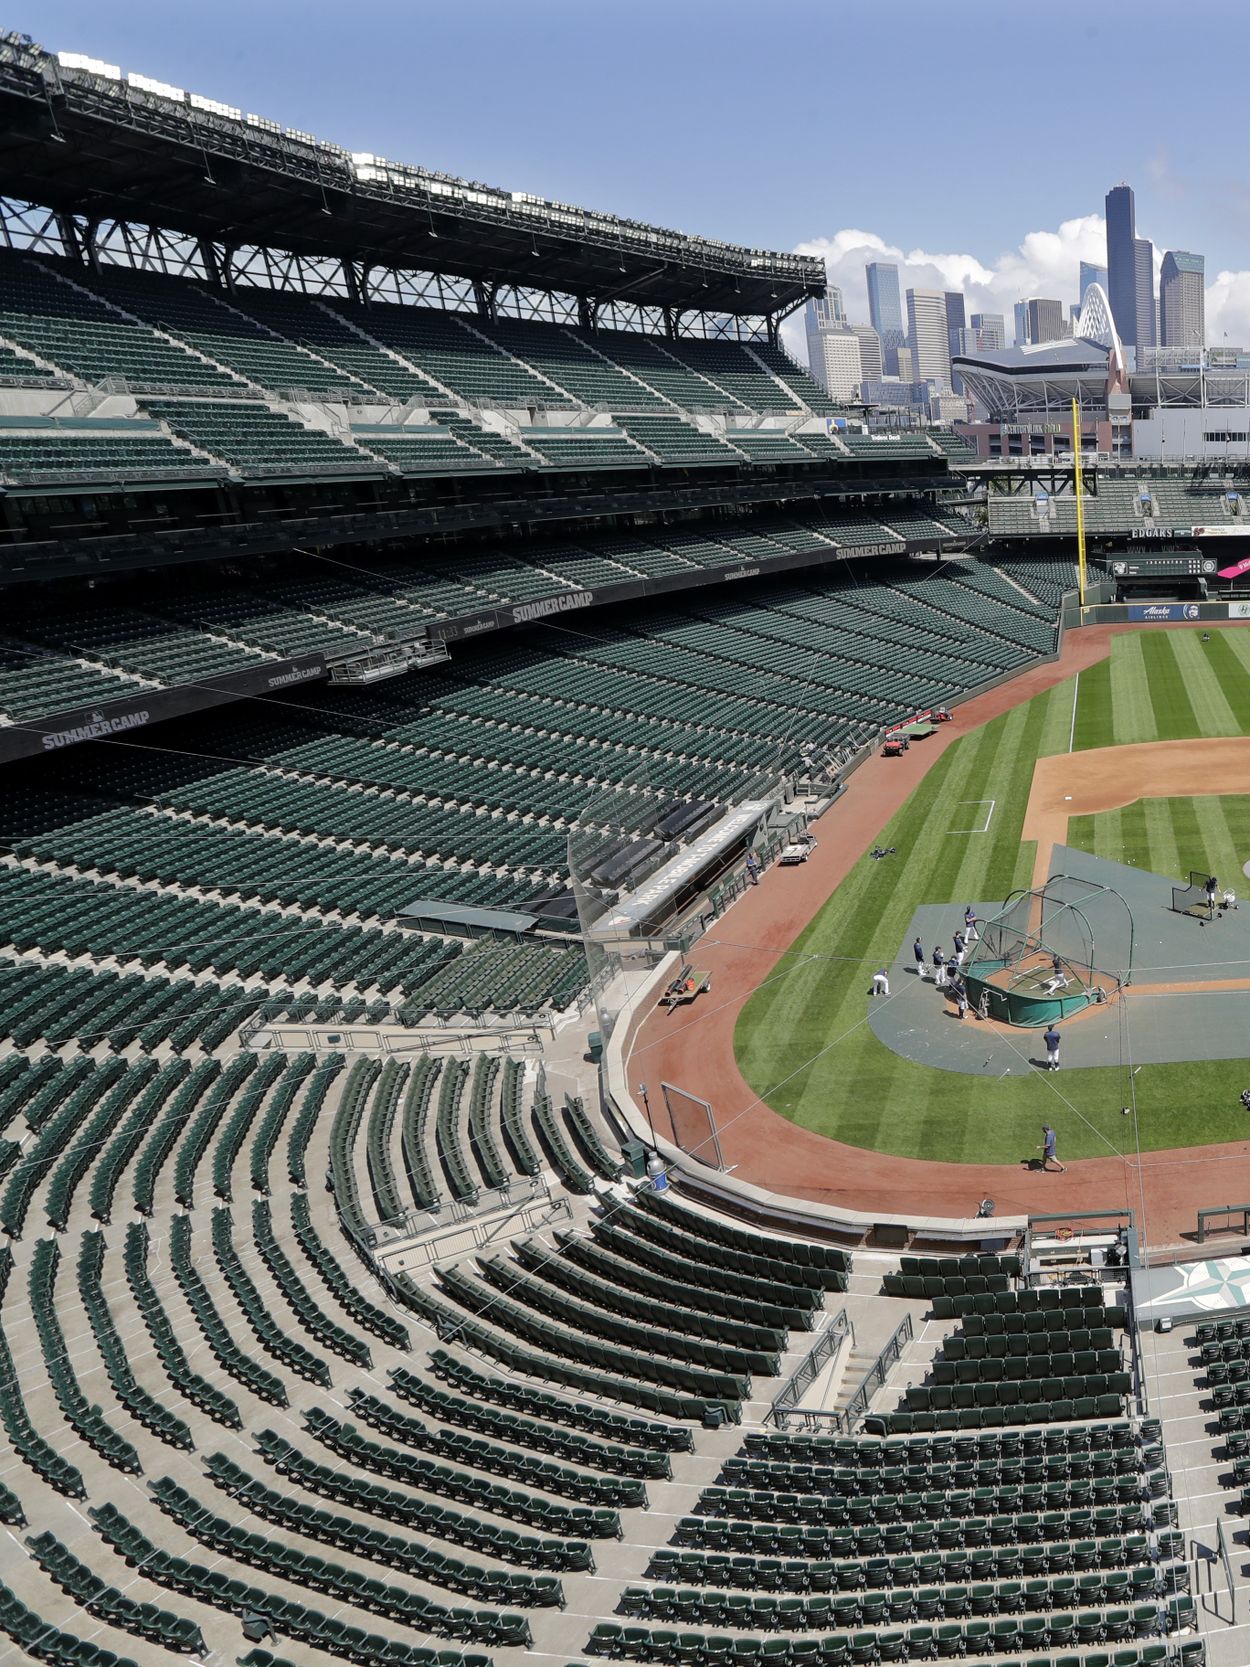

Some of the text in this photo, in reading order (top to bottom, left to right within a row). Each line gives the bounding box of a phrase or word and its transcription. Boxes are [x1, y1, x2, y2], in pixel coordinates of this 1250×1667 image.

[512, 592, 594, 624] SUMMER CAMP
[1144, 606, 1170, 615] Alaska
[42, 710, 150, 750] SUMMER CAMP
